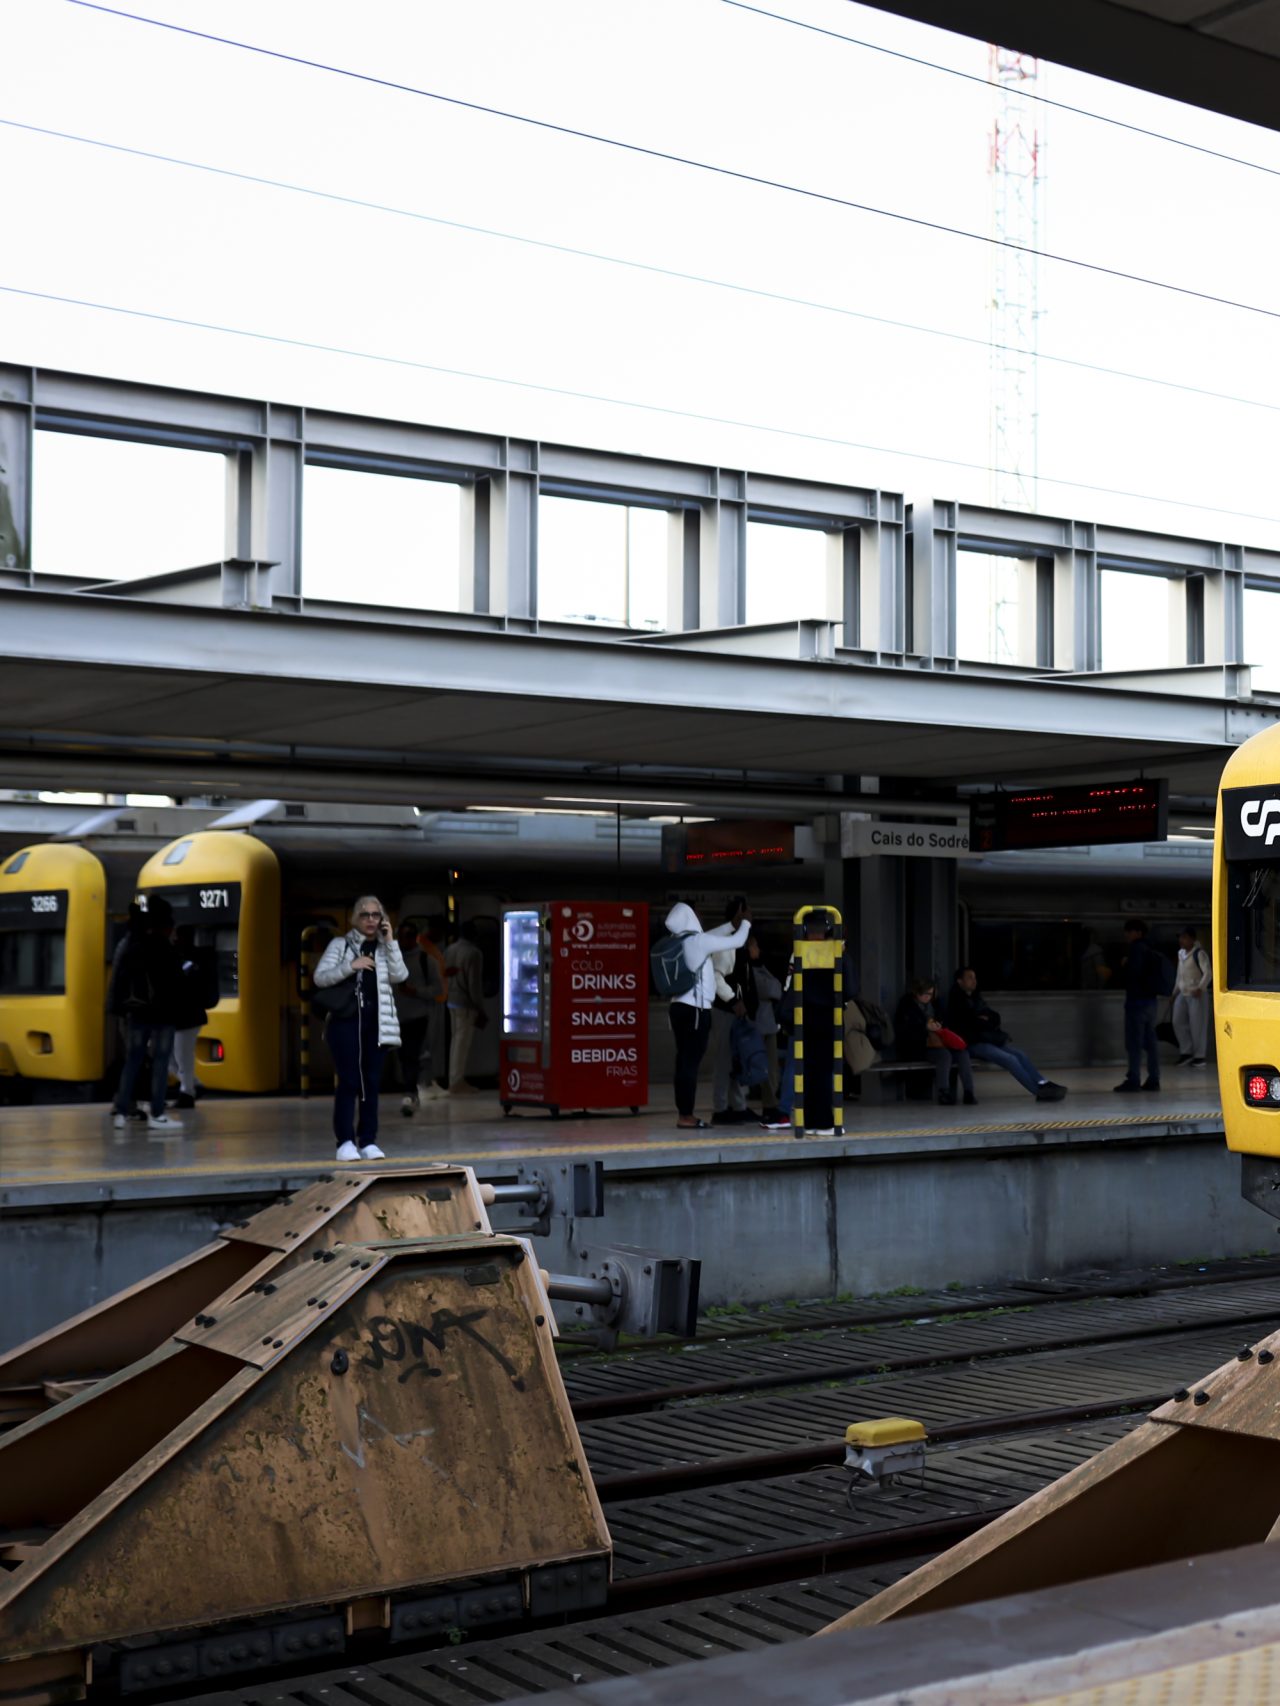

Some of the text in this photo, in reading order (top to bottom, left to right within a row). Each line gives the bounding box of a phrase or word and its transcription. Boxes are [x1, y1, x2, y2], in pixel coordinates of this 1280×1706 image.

[871, 830, 969, 849] Cais do Sodré
[199, 889, 228, 909] 3271
[571, 960, 604, 971] COLD
[571, 974, 636, 990] DRINKS
[571, 1011, 636, 1026] SNACKS
[571, 1048, 637, 1063] BEBIDAS
